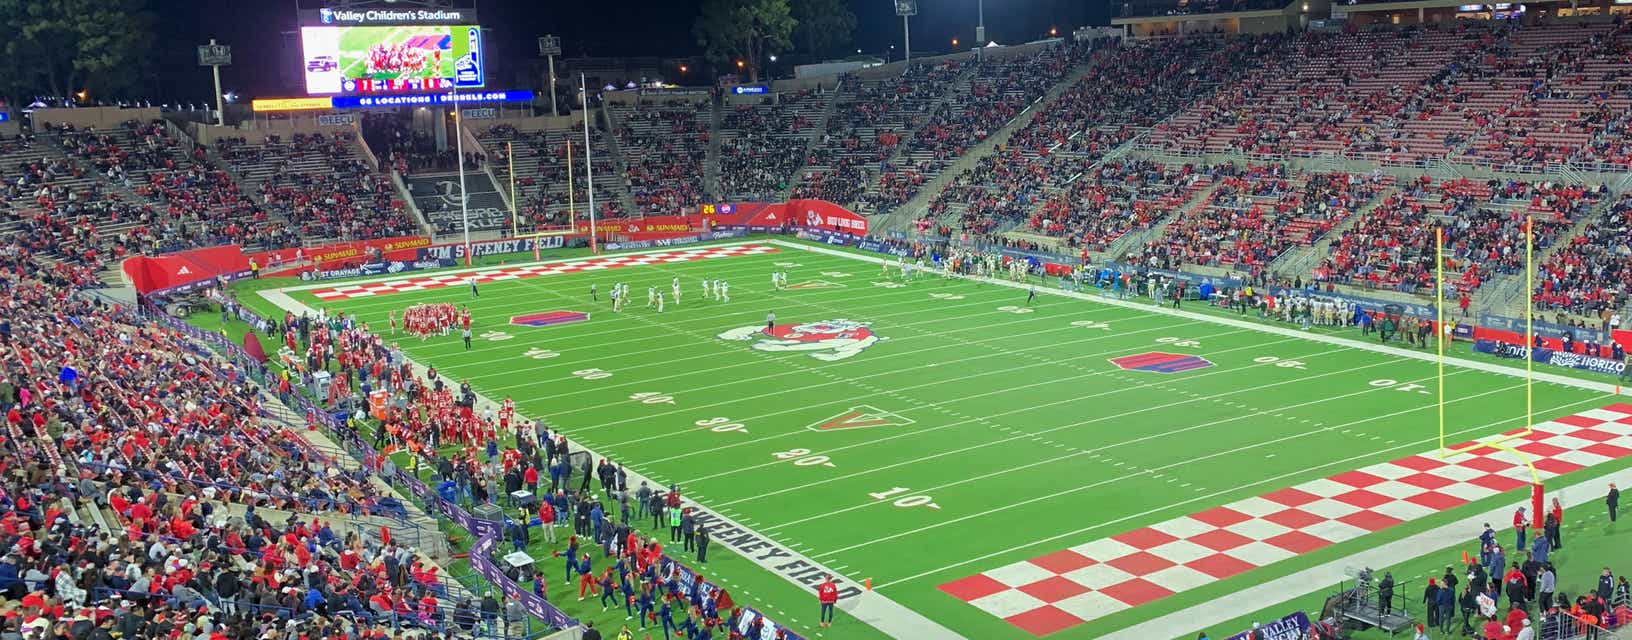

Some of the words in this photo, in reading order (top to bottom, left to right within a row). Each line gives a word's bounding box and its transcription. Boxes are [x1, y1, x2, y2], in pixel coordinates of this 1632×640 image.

[333, 11, 365, 22] Valley
[366, 10, 416, 20] Children's
[417, 10, 460, 20] Stadium
[375, 96, 430, 104] LOCATIONS
[703, 205, 715, 214] 26
[445, 217, 506, 231] EXUS
[524, 236, 563, 251] FELD
[1581, 356, 1626, 372] HORIZO
[696, 417, 745, 432] 30
[771, 448, 831, 466] 20
[868, 487, 933, 507] 10
[774, 559, 862, 600] FIED
[1262, 616, 1300, 637] VALLEY
